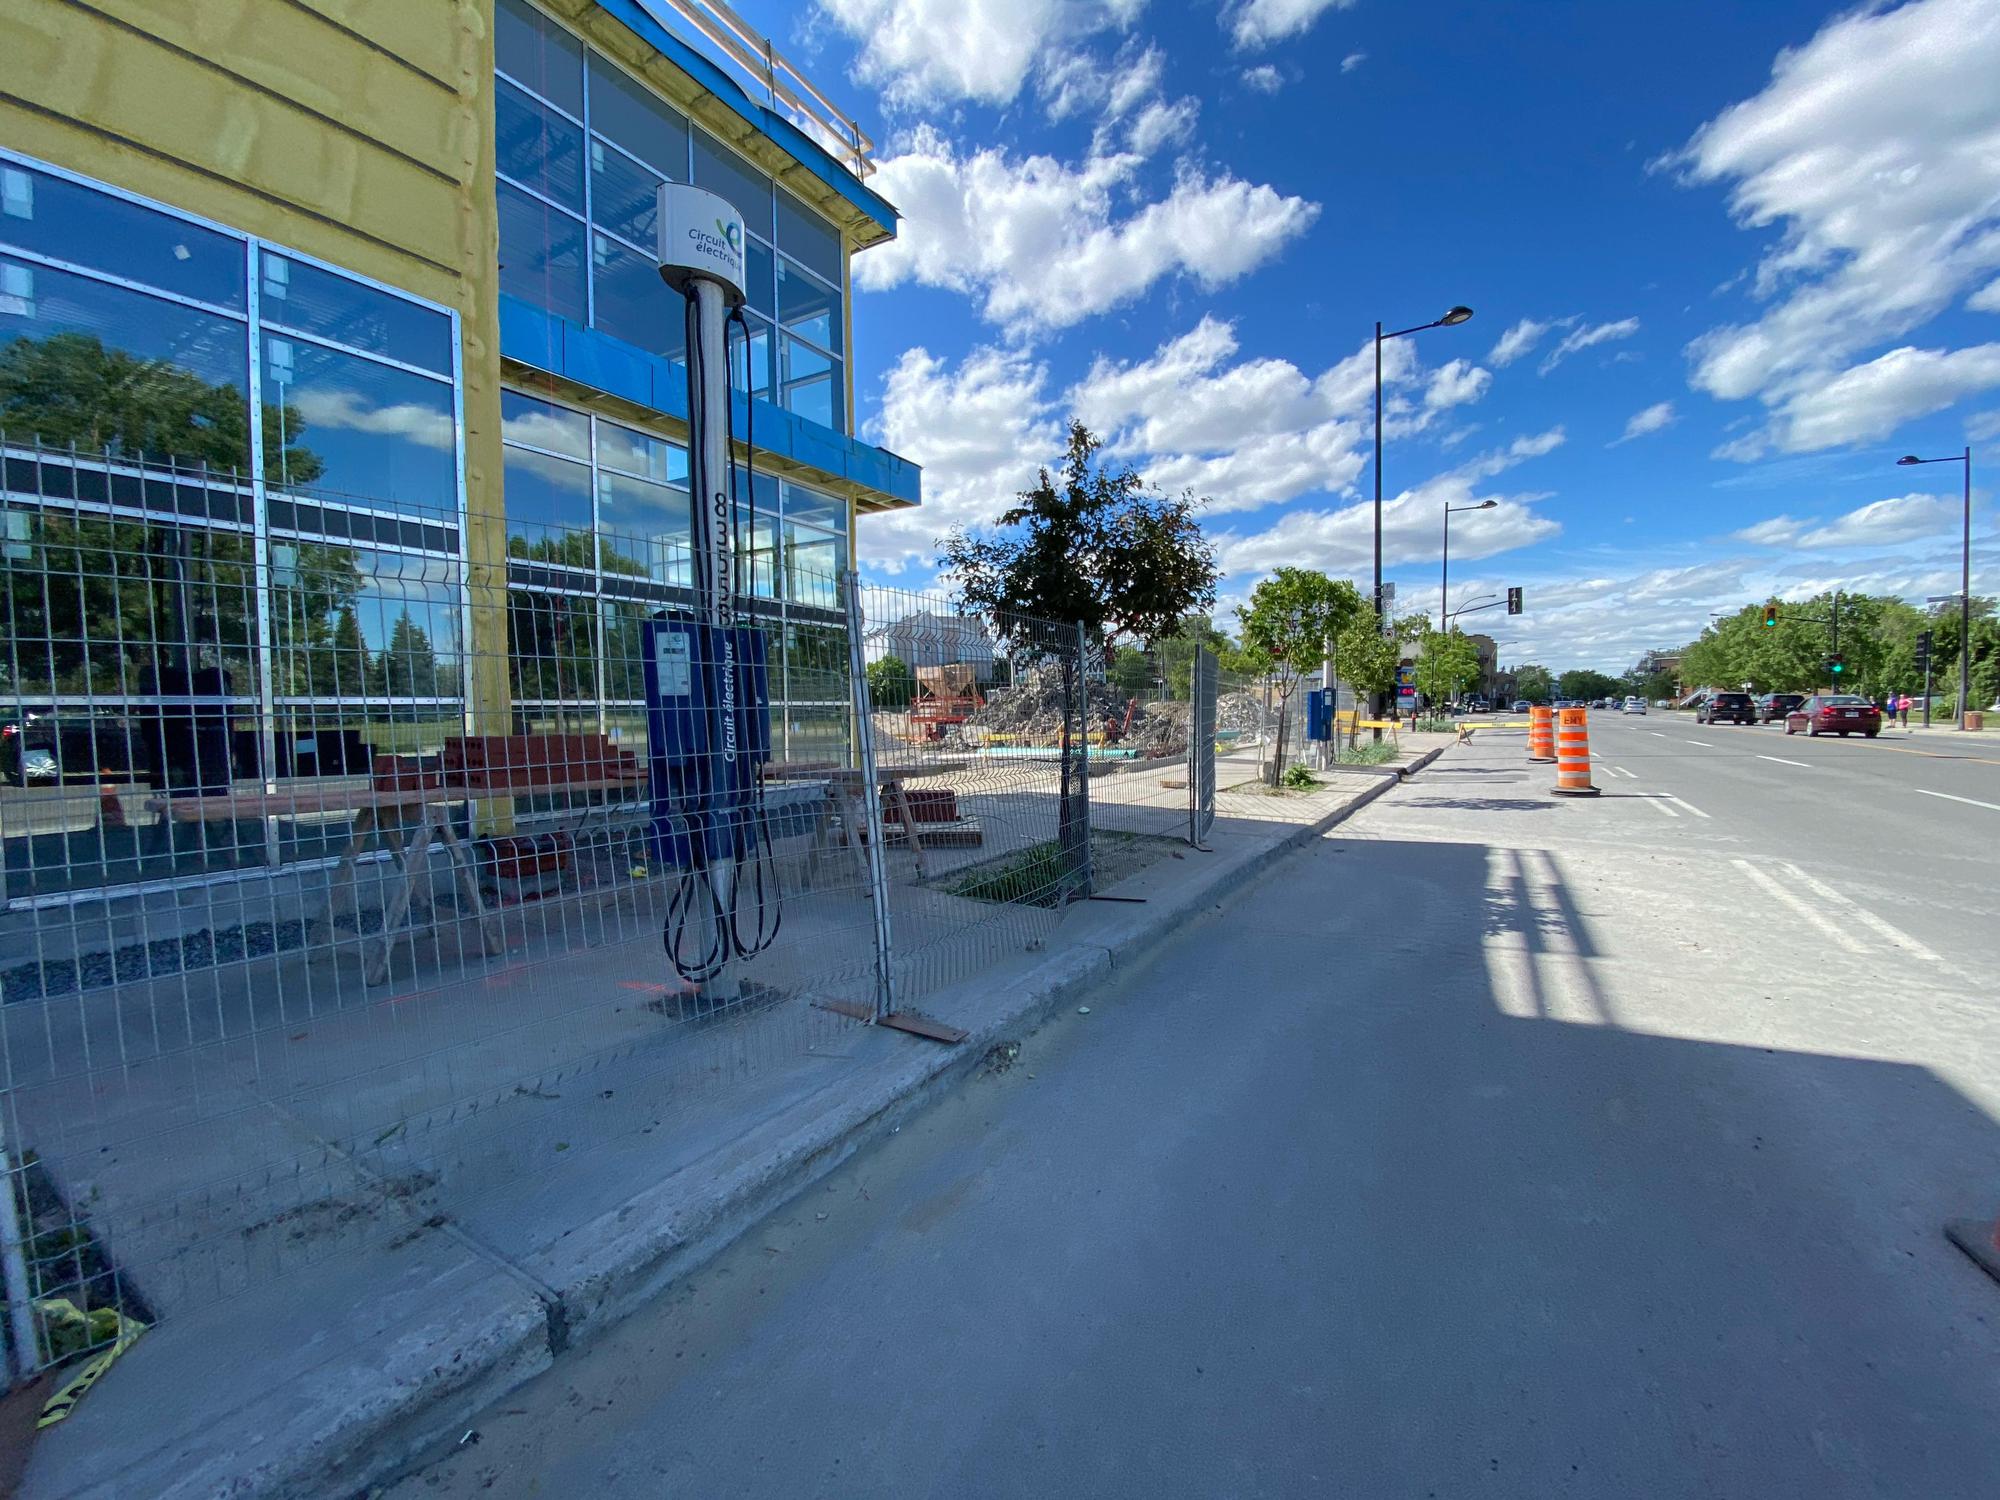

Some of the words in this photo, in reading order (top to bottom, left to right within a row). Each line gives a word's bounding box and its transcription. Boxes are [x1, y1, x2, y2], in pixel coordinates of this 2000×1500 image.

[688, 229, 726, 250] Circuit
[722, 641, 735, 712] électrique
[724, 715, 735, 763] Circuit
